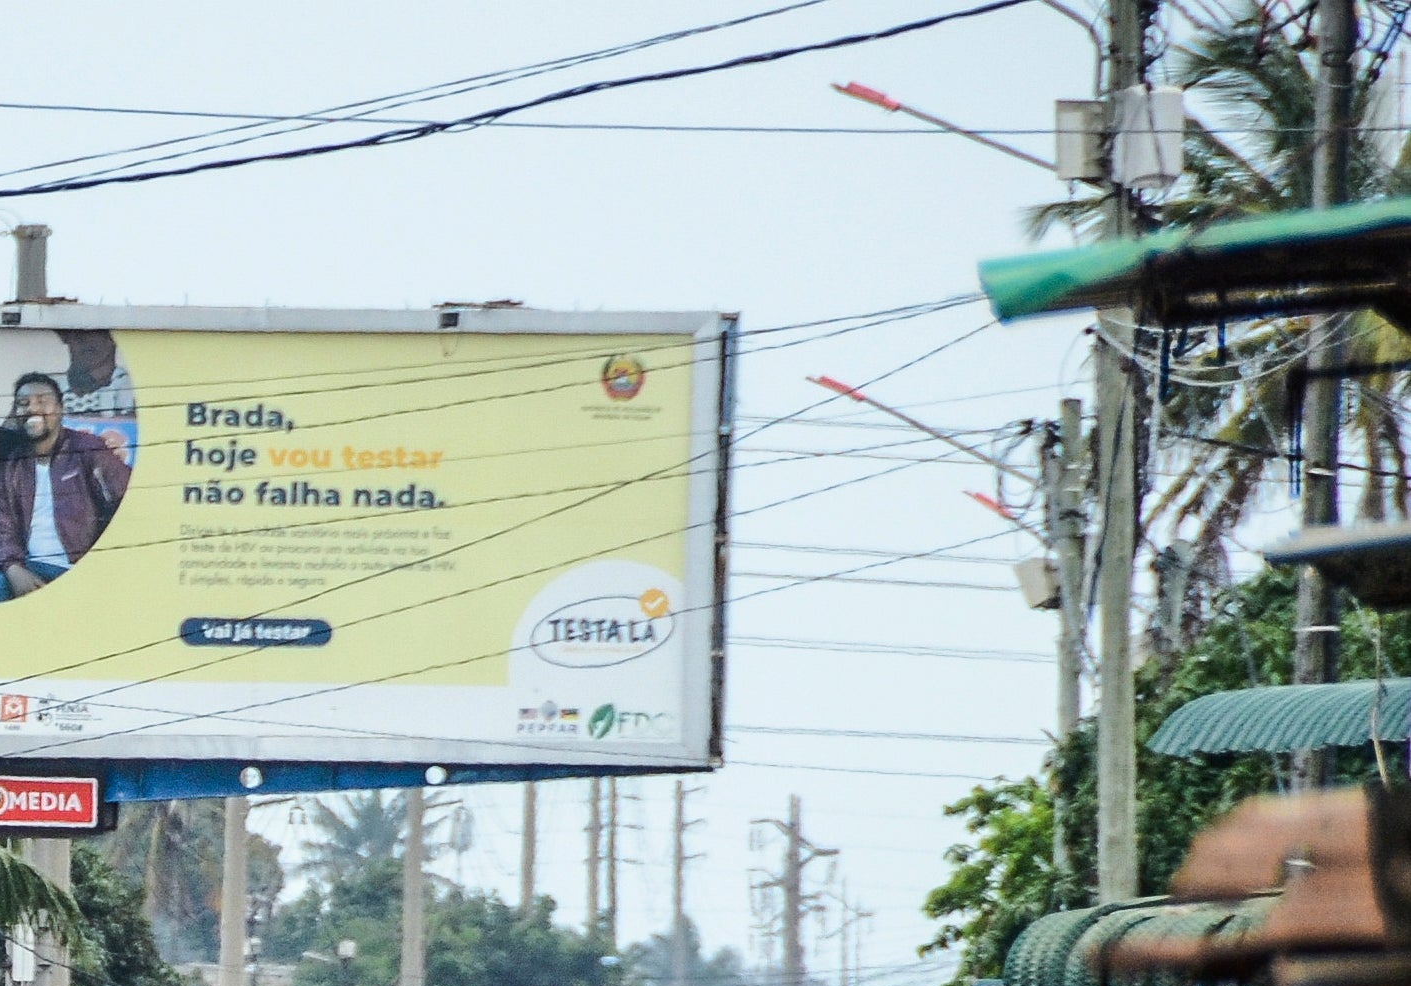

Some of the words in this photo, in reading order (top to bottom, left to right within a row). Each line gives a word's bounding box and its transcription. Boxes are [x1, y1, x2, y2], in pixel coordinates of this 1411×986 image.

[187, 402, 293, 433] Brada,
[186, 439, 256, 472] hoje
[268, 447, 331, 468] vou
[342, 446, 444, 470] testar
[184, 479, 244, 505] não
[255, 481, 340, 506] falha
[354, 484, 445, 508] nada.
[6, 791, 83, 813] MEDIA
